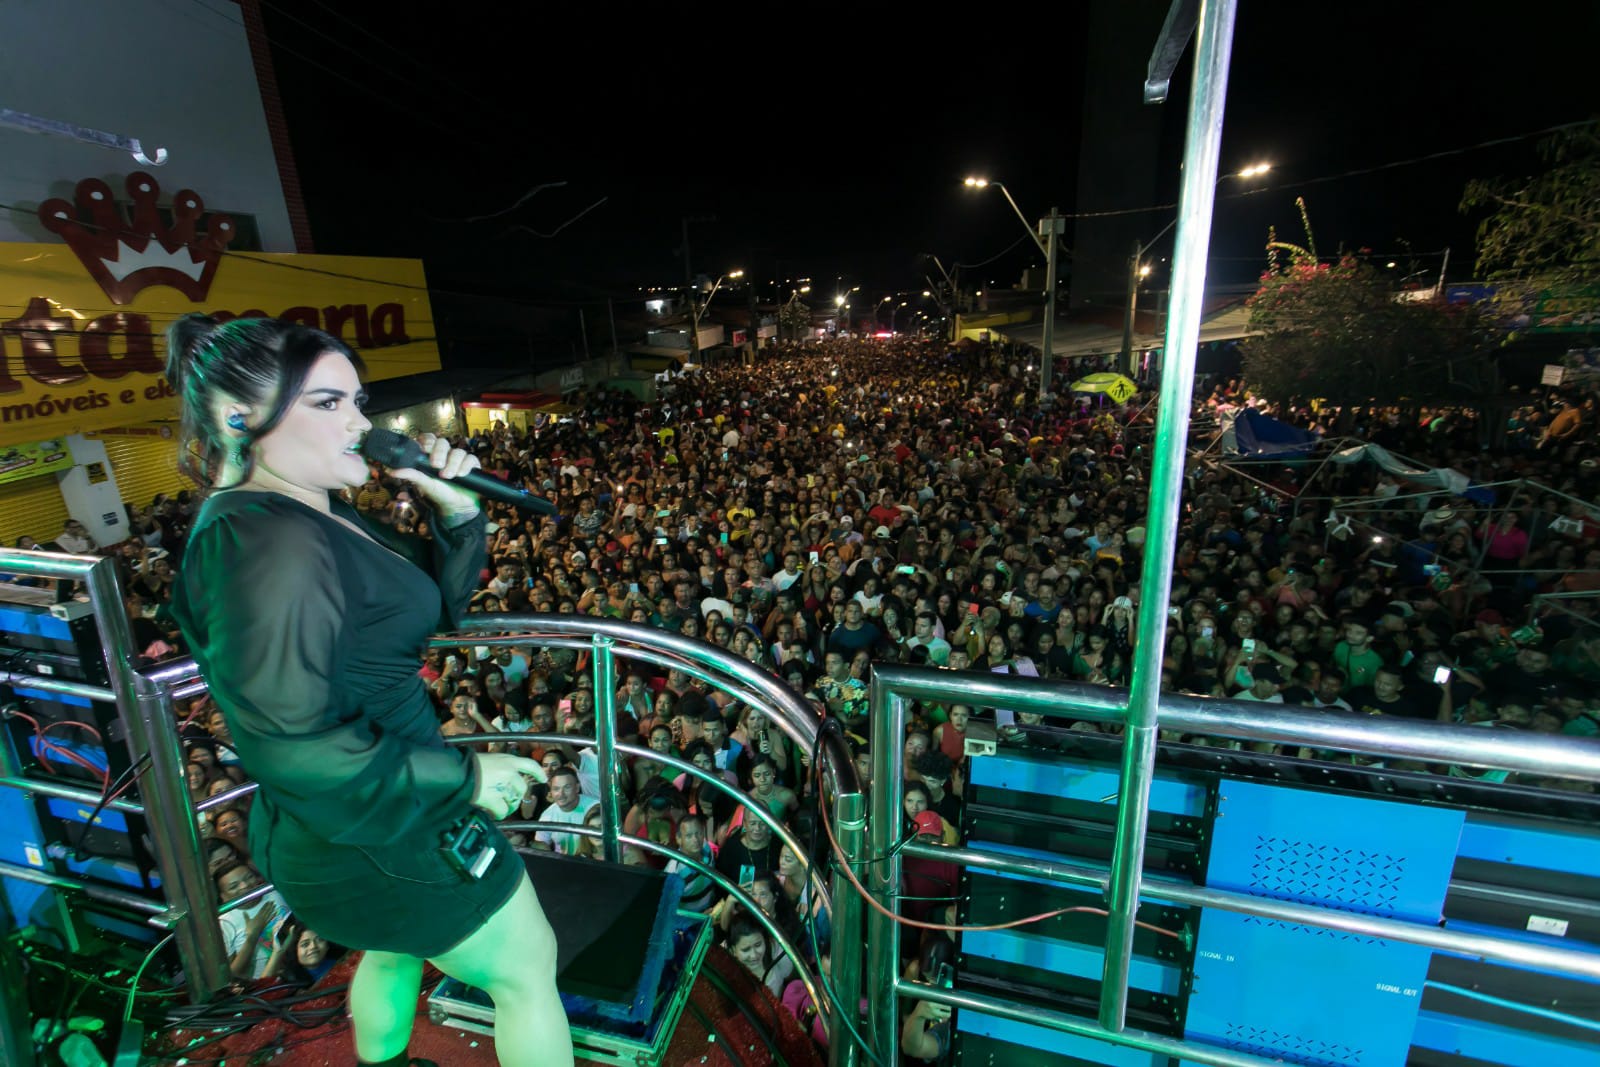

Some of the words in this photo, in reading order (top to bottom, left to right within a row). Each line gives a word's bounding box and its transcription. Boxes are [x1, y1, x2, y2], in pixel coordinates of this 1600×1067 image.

[208, 302, 410, 349] aria
[2, 389, 110, 422] móveis
[119, 389, 136, 404] e
[144, 378, 176, 399] ele
[1199, 950, 1223, 961] SIGNAL
[1226, 954, 1235, 962] IN
[1376, 982, 1402, 994] SIGNAL
[1402, 988, 1418, 998] OUT
